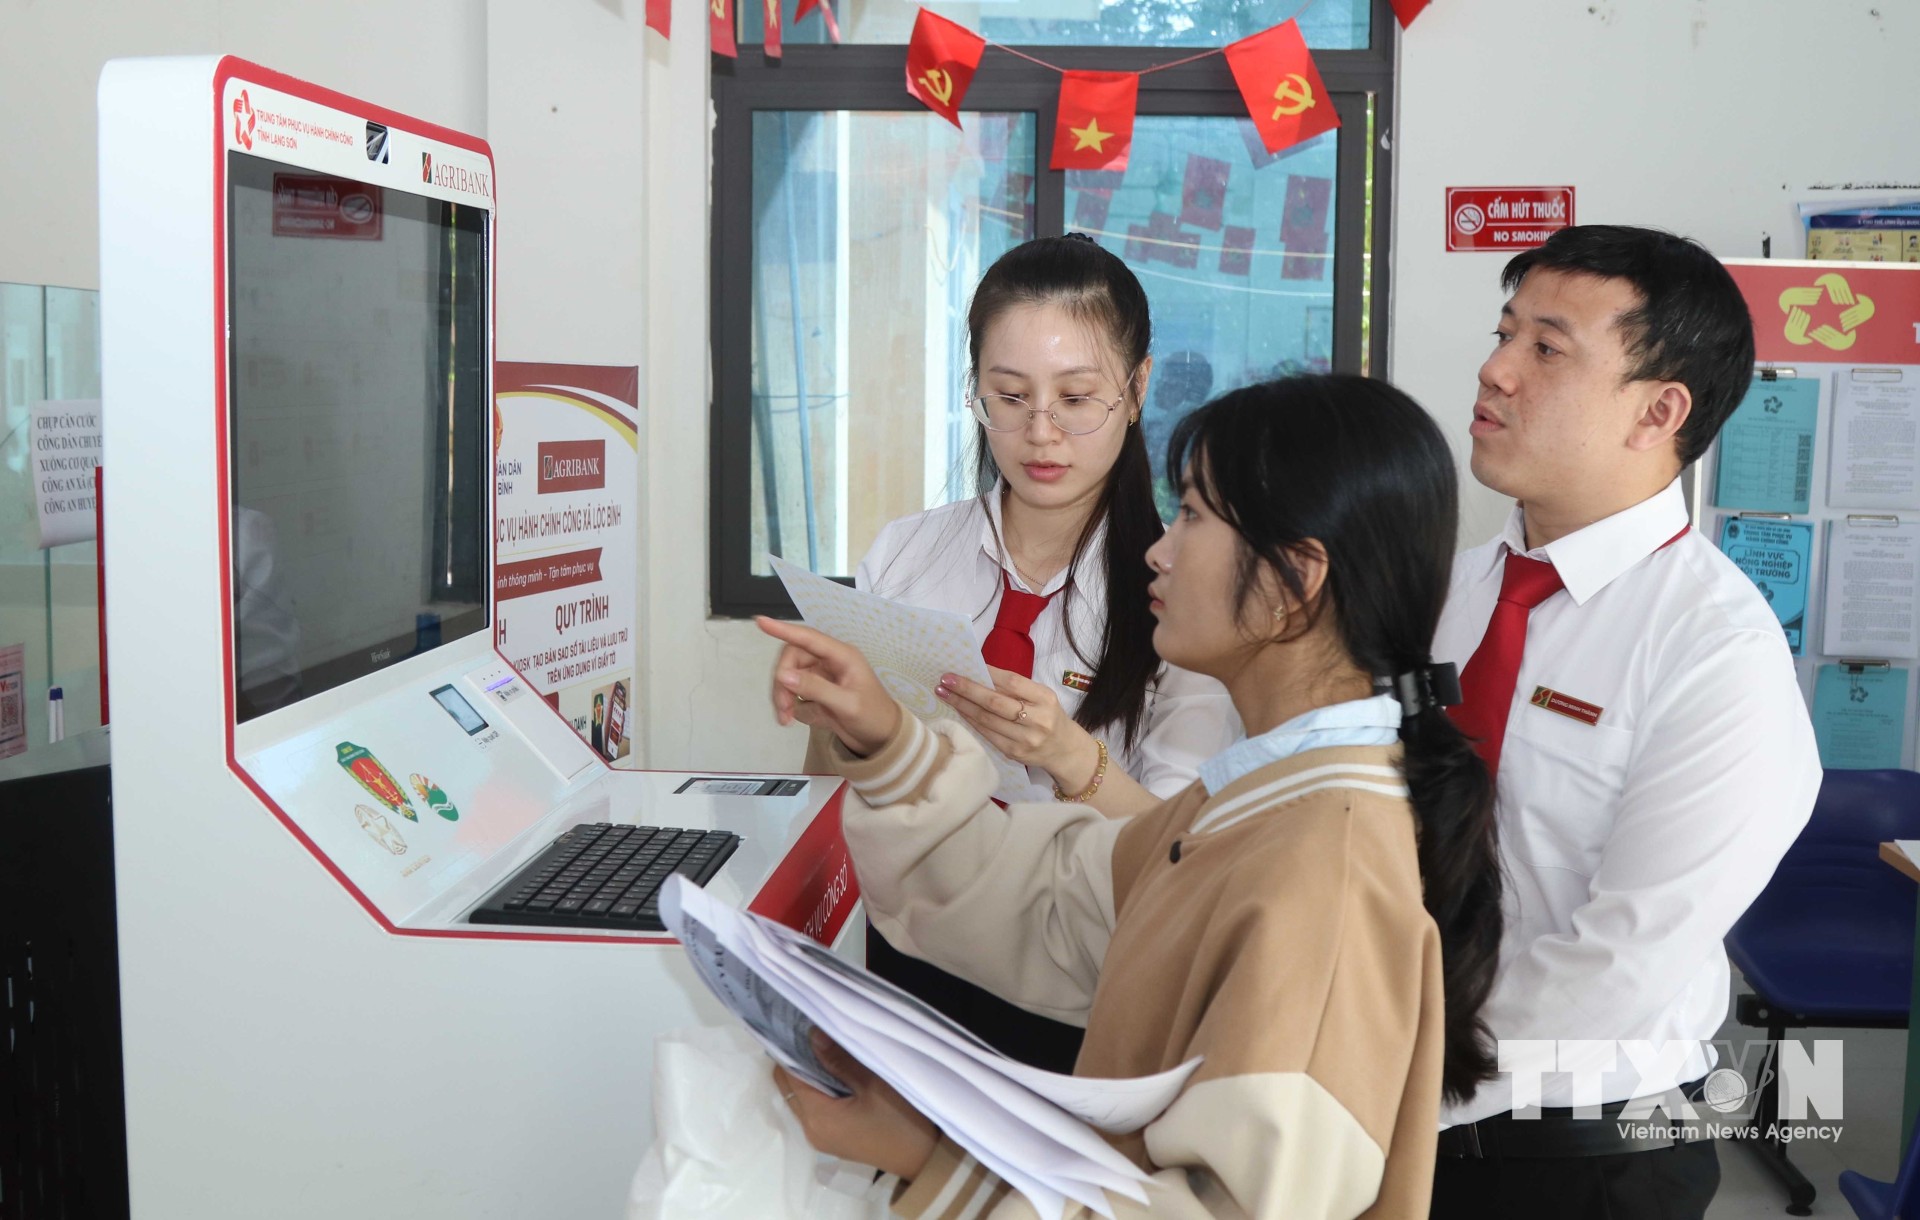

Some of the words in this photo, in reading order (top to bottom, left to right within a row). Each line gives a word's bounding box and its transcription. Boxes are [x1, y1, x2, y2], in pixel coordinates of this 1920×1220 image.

[257, 109, 275, 125] TRUNG
[276, 113, 287, 128] TÂM
[287, 118, 302, 134] PHỤC
[302, 123, 310, 137] VỤ
[310, 121, 325, 138] HÀNH
[325, 128, 339, 142] CHÍNH
[339, 131, 353, 146] CÔNG
[257, 126, 271, 143] TỈNH
[286, 137, 297, 150] SƠN
[434, 163, 489, 197] AGRIBANK
[1487, 197, 1509, 219] CẤM
[1512, 199, 1530, 218] HÚT
[1532, 196, 1566, 218] THUỐC
[1494, 231, 1509, 242] NO
[37, 416, 58, 432] CHỤP
[60, 413, 75, 429] CĂN
[37, 434, 60, 451] CÔNG
[62, 433, 77, 449] DÂN
[40, 455, 67, 472] XUỐNG
[68, 457, 80, 470] CƠ
[508, 459, 521, 475] DÂN
[553, 458, 599, 478] AGRIBANK
[42, 476, 63, 493] CÔNG
[65, 477, 76, 491] AN
[76, 474, 86, 489] XÃ
[498, 479, 512, 495] BÌNH
[44, 498, 65, 514] CÔNG
[67, 499, 77, 512] AN
[506, 518, 516, 547] VỤ
[519, 509, 538, 540] HÀNH
[540, 507, 561, 537] CHÍNH
[563, 505, 581, 533] CÔNG
[583, 503, 591, 531] XÃ
[593, 504, 605, 534] LỘC
[607, 499, 621, 528] BÌNH
[1736, 556, 1759, 567] NÔNG
[1762, 559, 1793, 570] NGHIỆP
[1745, 547, 1765, 559] LĨNH
[1768, 551, 1784, 560] VỰC
[509, 573, 526, 587] thông
[528, 569, 542, 584] minh
[549, 567, 559, 582] Tận
[560, 565, 571, 577] tâm
[572, 562, 586, 578] phục
[587, 562, 594, 574] vụ
[1755, 567, 1791, 579] TRƯỜNG
[556, 602, 577, 635] QUY
[579, 593, 609, 625] TRÌNH
[533, 653, 543, 670] TẠO
[545, 648, 556, 665] BẢN
[558, 646, 568, 661] SAO
[570, 639, 577, 657] SỐ
[588, 637, 599, 653] LIỆU
[600, 633, 606, 649] VÀ
[608, 632, 617, 647] LƯU
[618, 627, 628, 643] TRỮ
[547, 666, 561, 685] TRÊN
[562, 664, 574, 680] ỨNG
[576, 660, 590, 678] DỤNG
[591, 656, 597, 671] VÍ
[598, 652, 608, 669] GIẤY
[610, 650, 616, 665] TỜ
[814, 901, 822, 938] VỤ
[823, 874, 840, 923] CÔNG
[840, 853, 848, 896] SỐ
